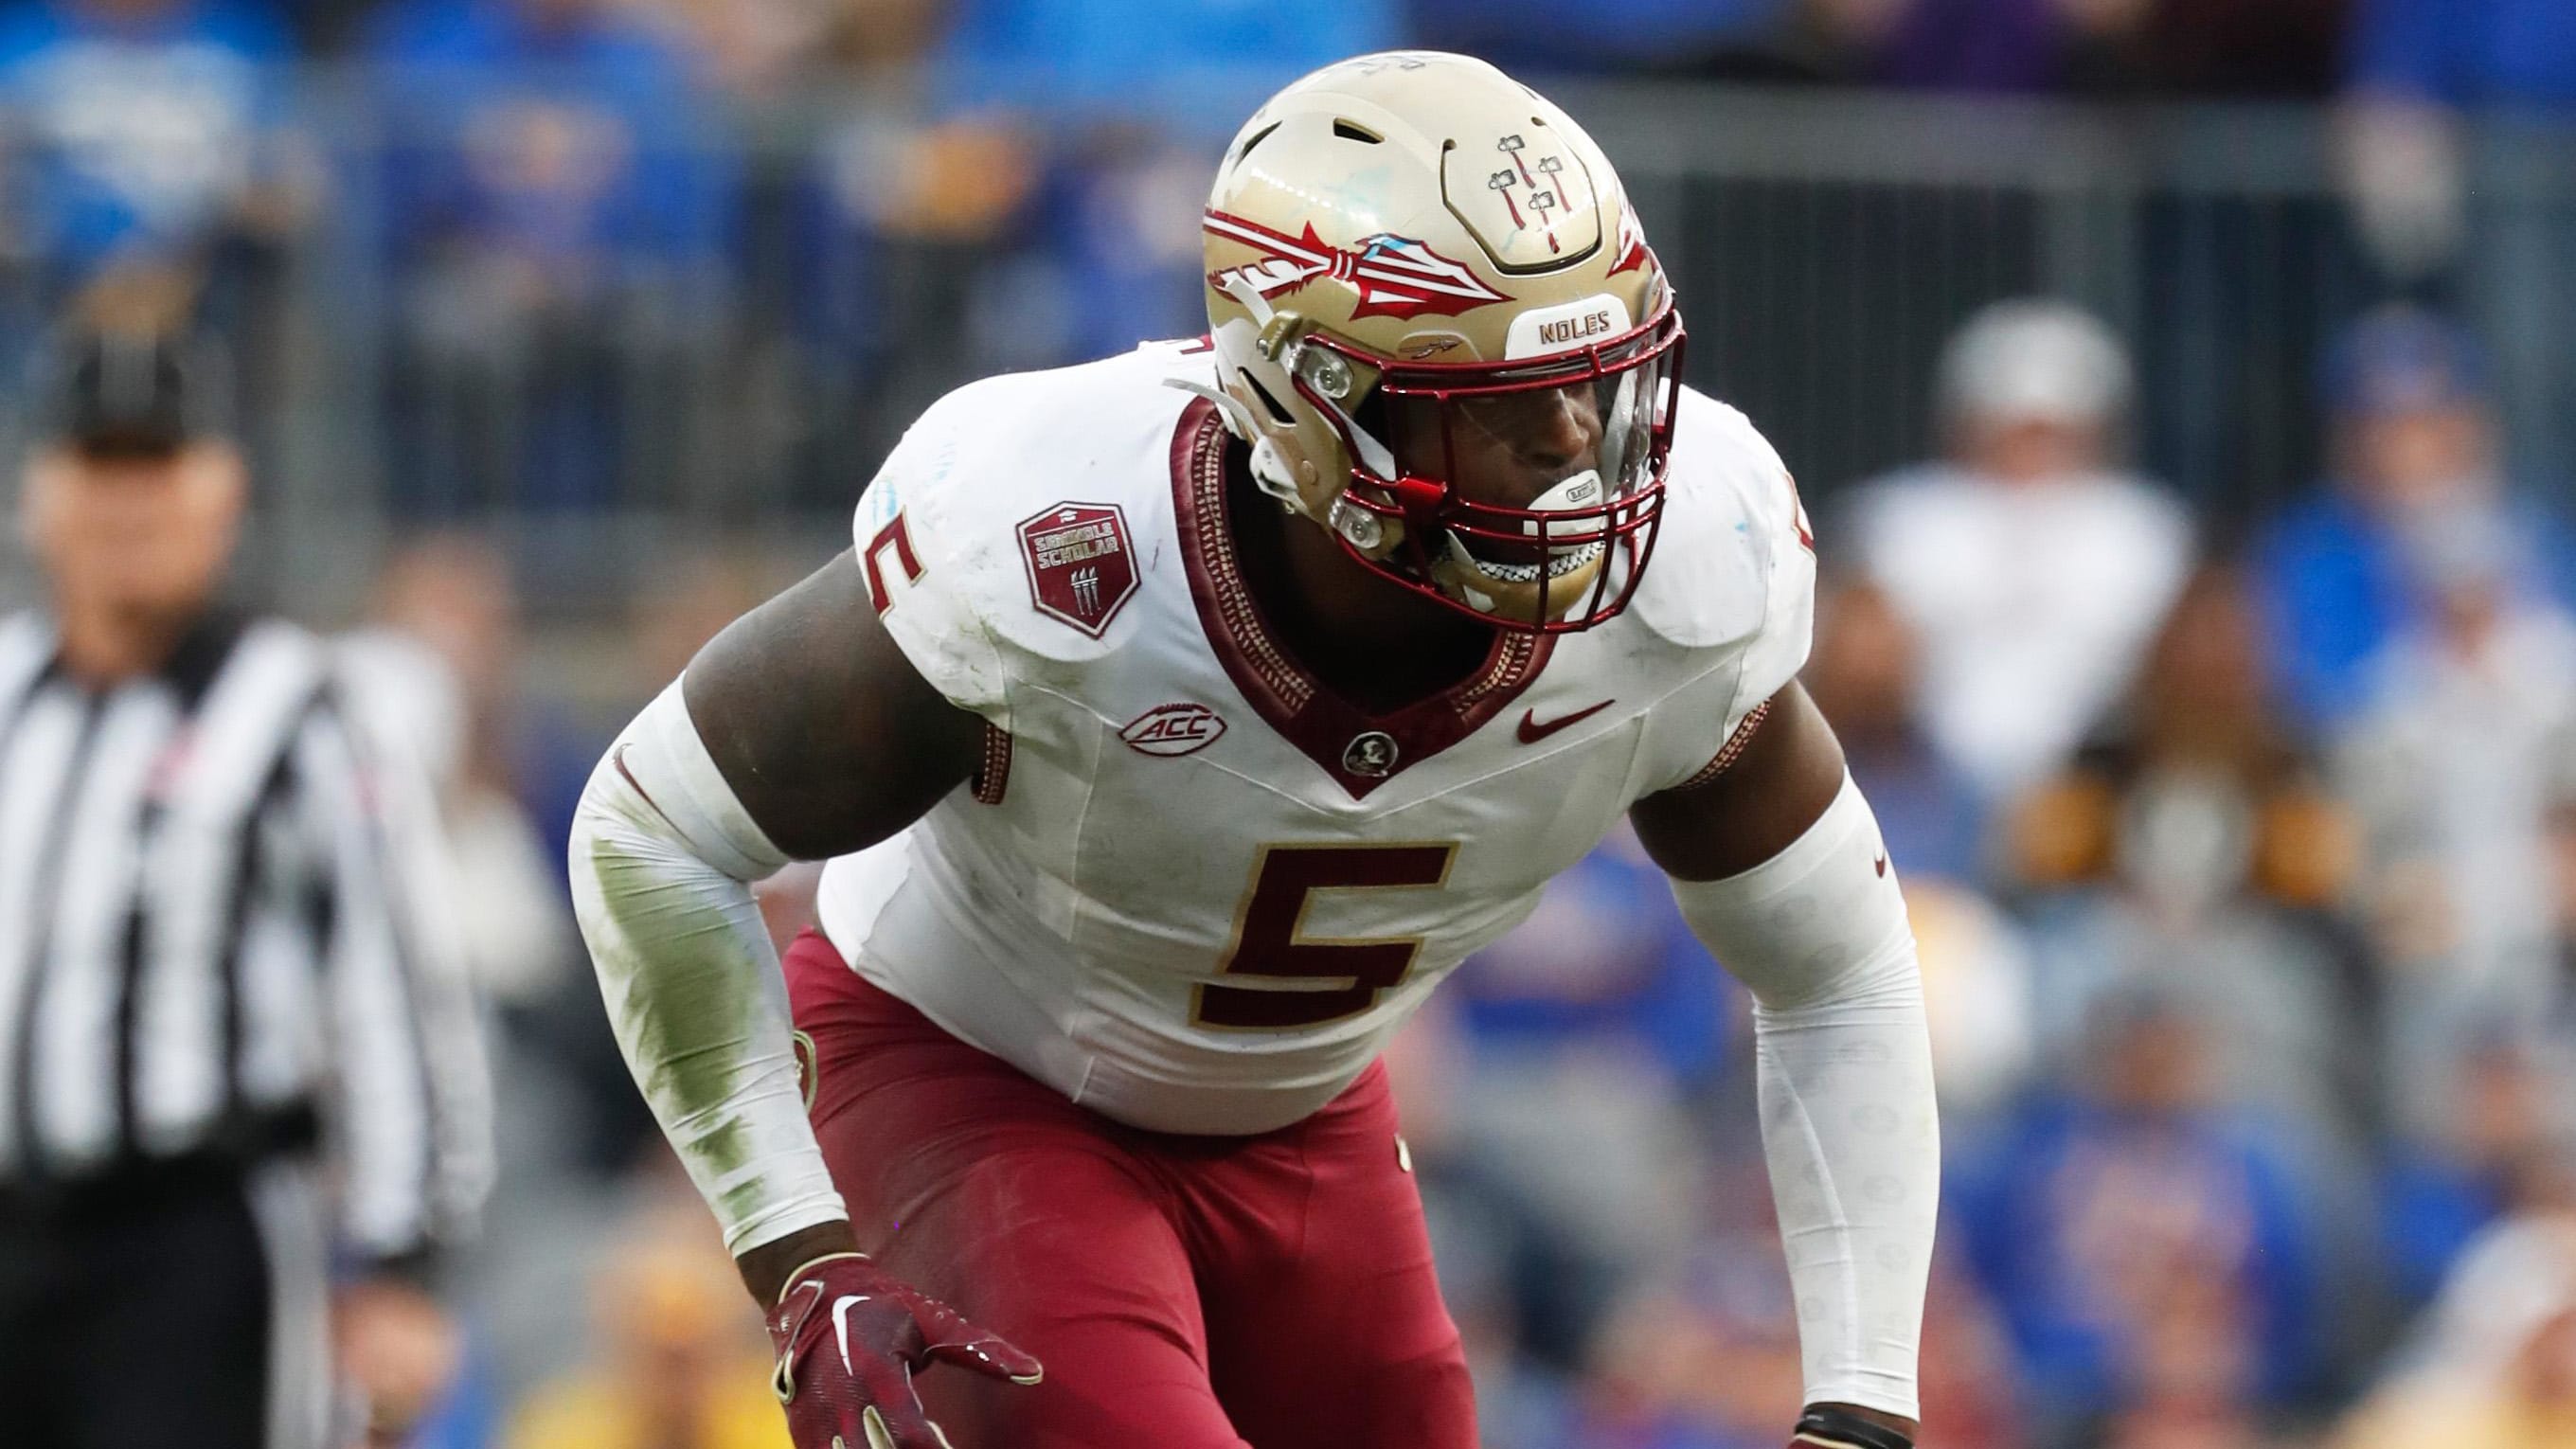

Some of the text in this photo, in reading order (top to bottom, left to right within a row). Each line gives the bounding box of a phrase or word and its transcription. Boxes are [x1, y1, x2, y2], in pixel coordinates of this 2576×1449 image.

[1539, 311, 1611, 345] NOLES
[1036, 537, 1119, 569] SCHOLAR
[1132, 715, 1212, 741] ACC
[1188, 840, 1461, 1034] 5
